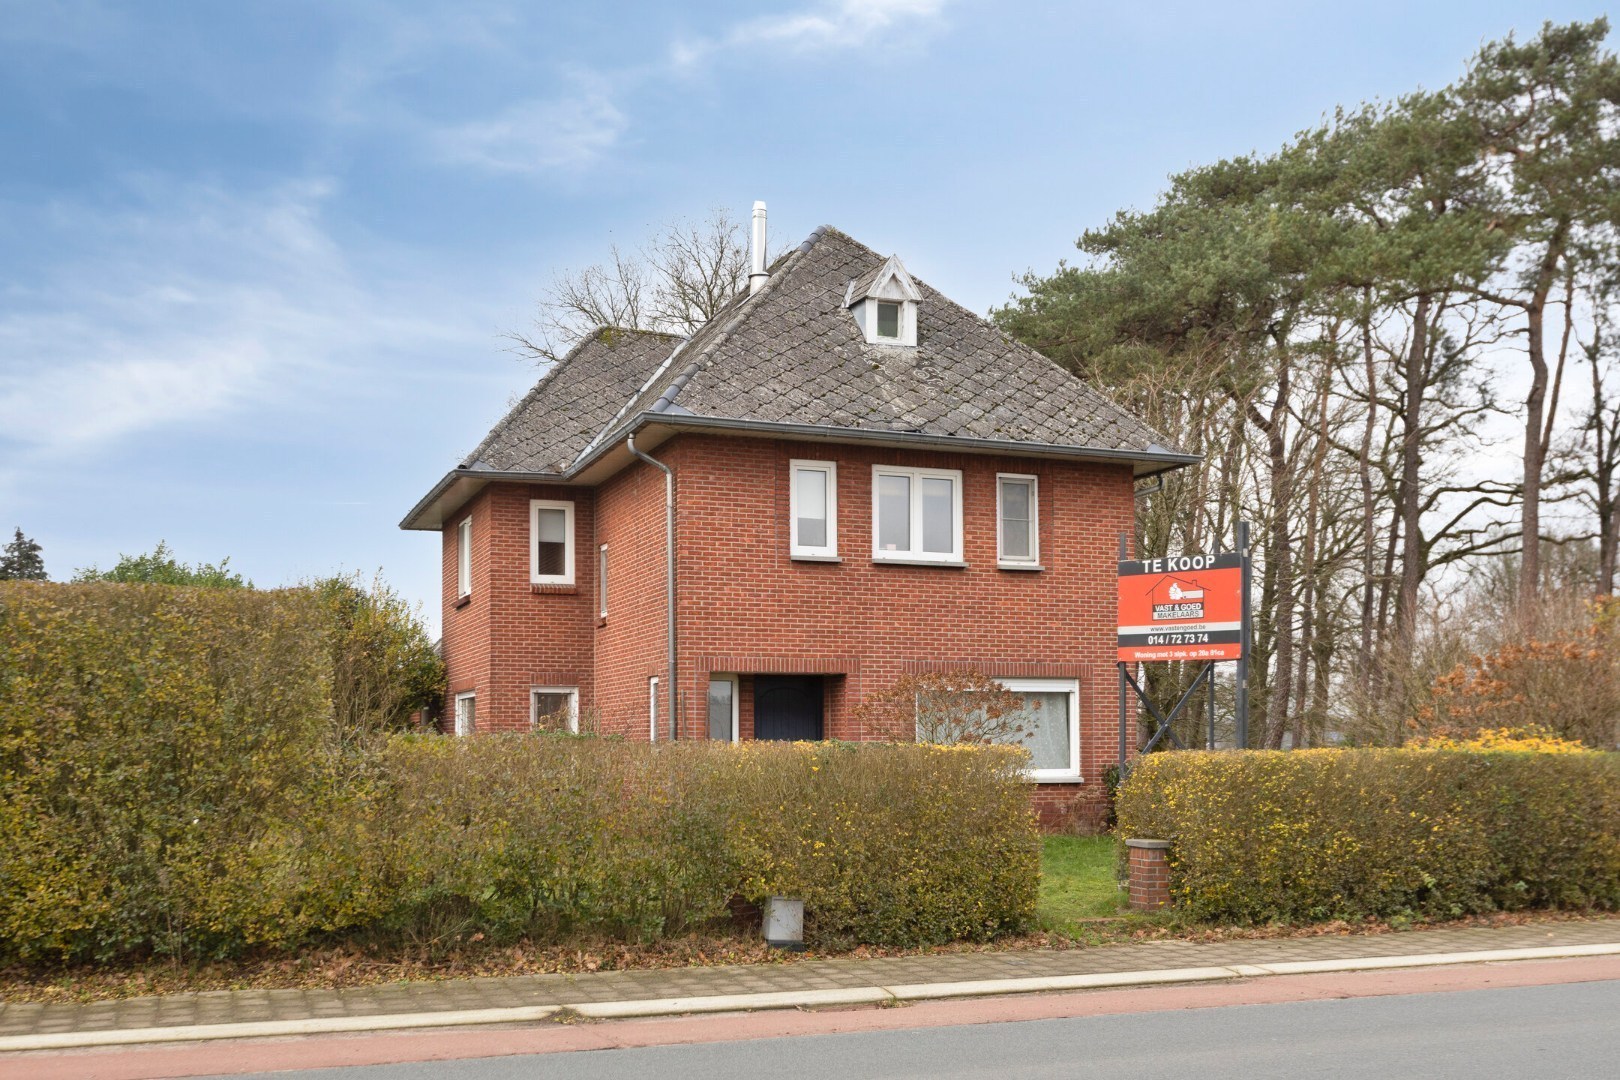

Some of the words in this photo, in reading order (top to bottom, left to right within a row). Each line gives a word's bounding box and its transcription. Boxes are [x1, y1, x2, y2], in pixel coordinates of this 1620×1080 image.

[1142, 559, 1162, 573] TE
[1167, 555, 1216, 572] KOOP
[1155, 604, 1174, 612] VAST
[1180, 603, 1202, 611] GOED
[1156, 610, 1200, 619] MAKELAARS
[1150, 624, 1206, 632] www.vastengoed.be
[1147, 635, 1164, 645] 014
[1171, 634, 1182, 644] 72
[1184, 634, 1195, 643] 73
[1197, 633, 1208, 643] 74
[1134, 651, 1156, 659] Woning
